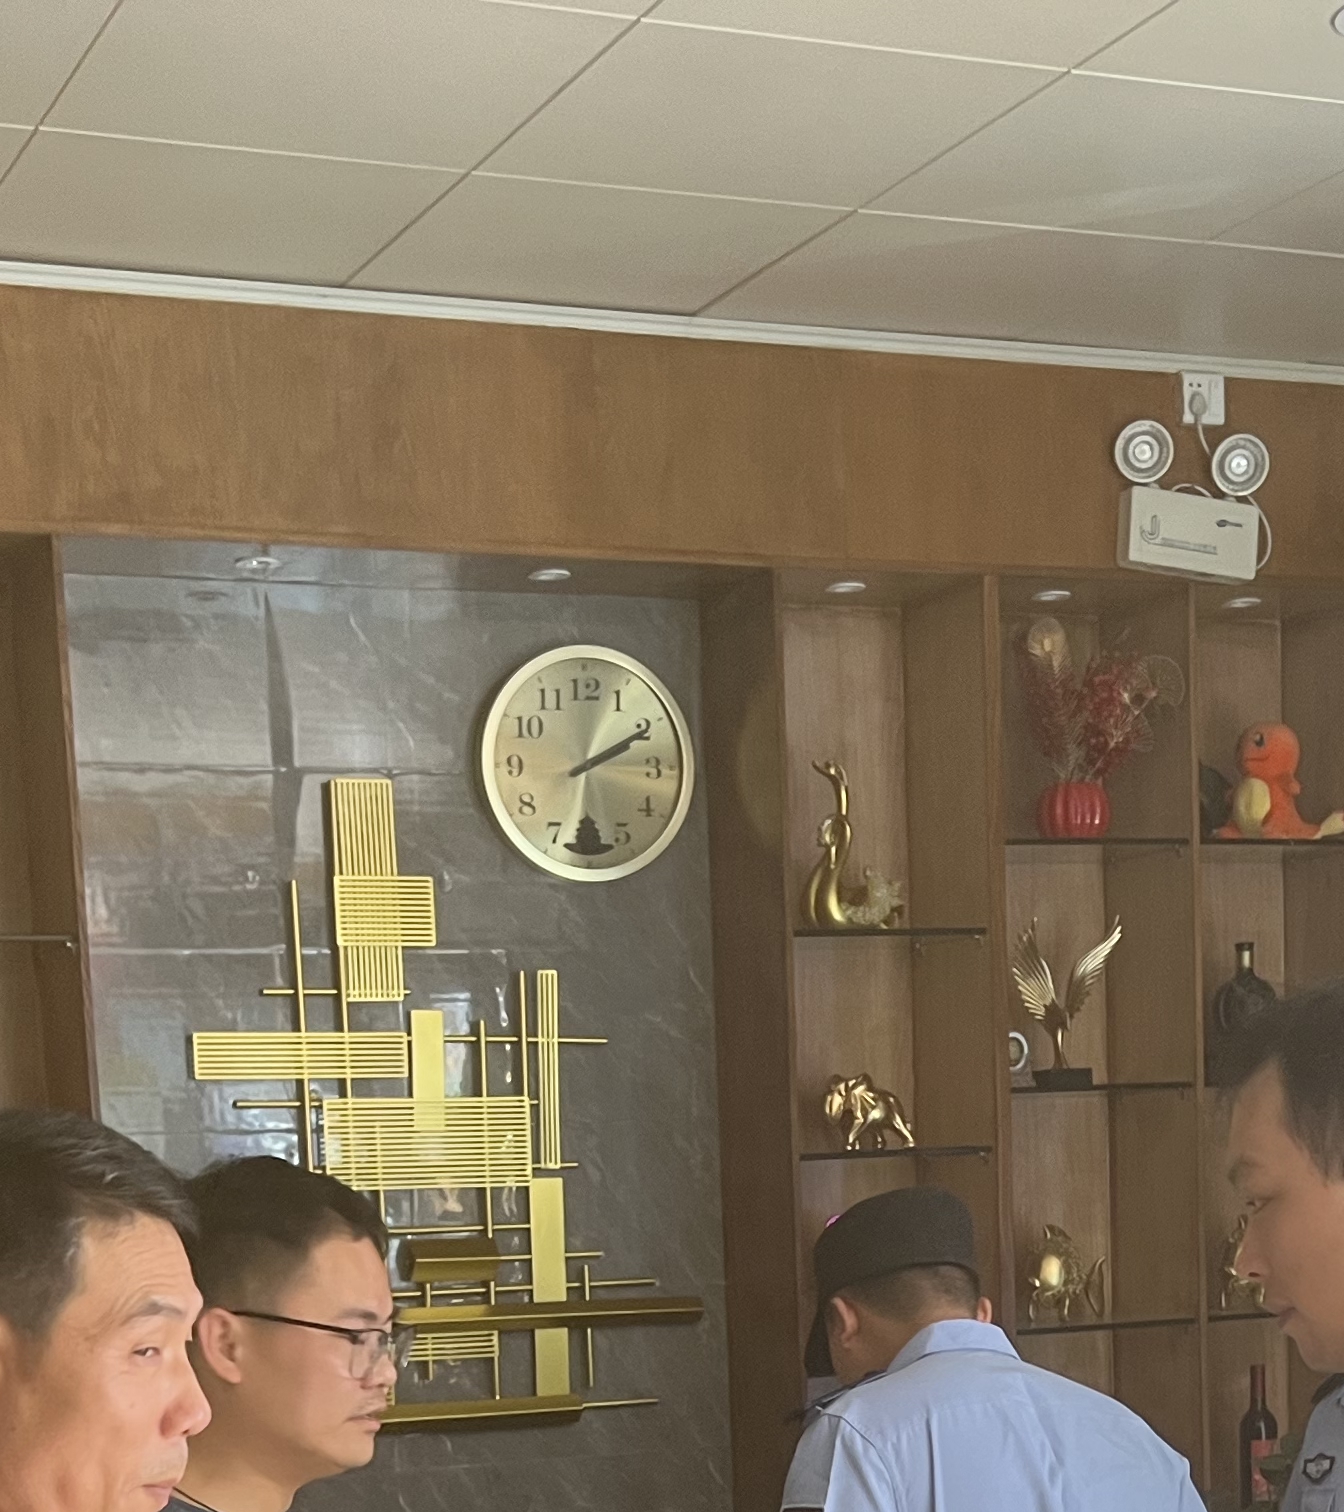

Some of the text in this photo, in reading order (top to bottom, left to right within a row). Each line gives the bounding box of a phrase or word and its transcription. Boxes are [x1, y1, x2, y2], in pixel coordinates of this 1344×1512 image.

[538, 688, 564, 711] 11
[570, 678, 600, 701] 12
[613, 689, 624, 712] 1
[516, 715, 544, 739] 10
[635, 717, 651, 741] 2
[506, 754, 524, 778] 9
[644, 756, 662, 780] 3
[518, 792, 536, 816] 8
[637, 795, 655, 818] 4
[546, 821, 562, 845] 7
[613, 822, 631, 846] 5
